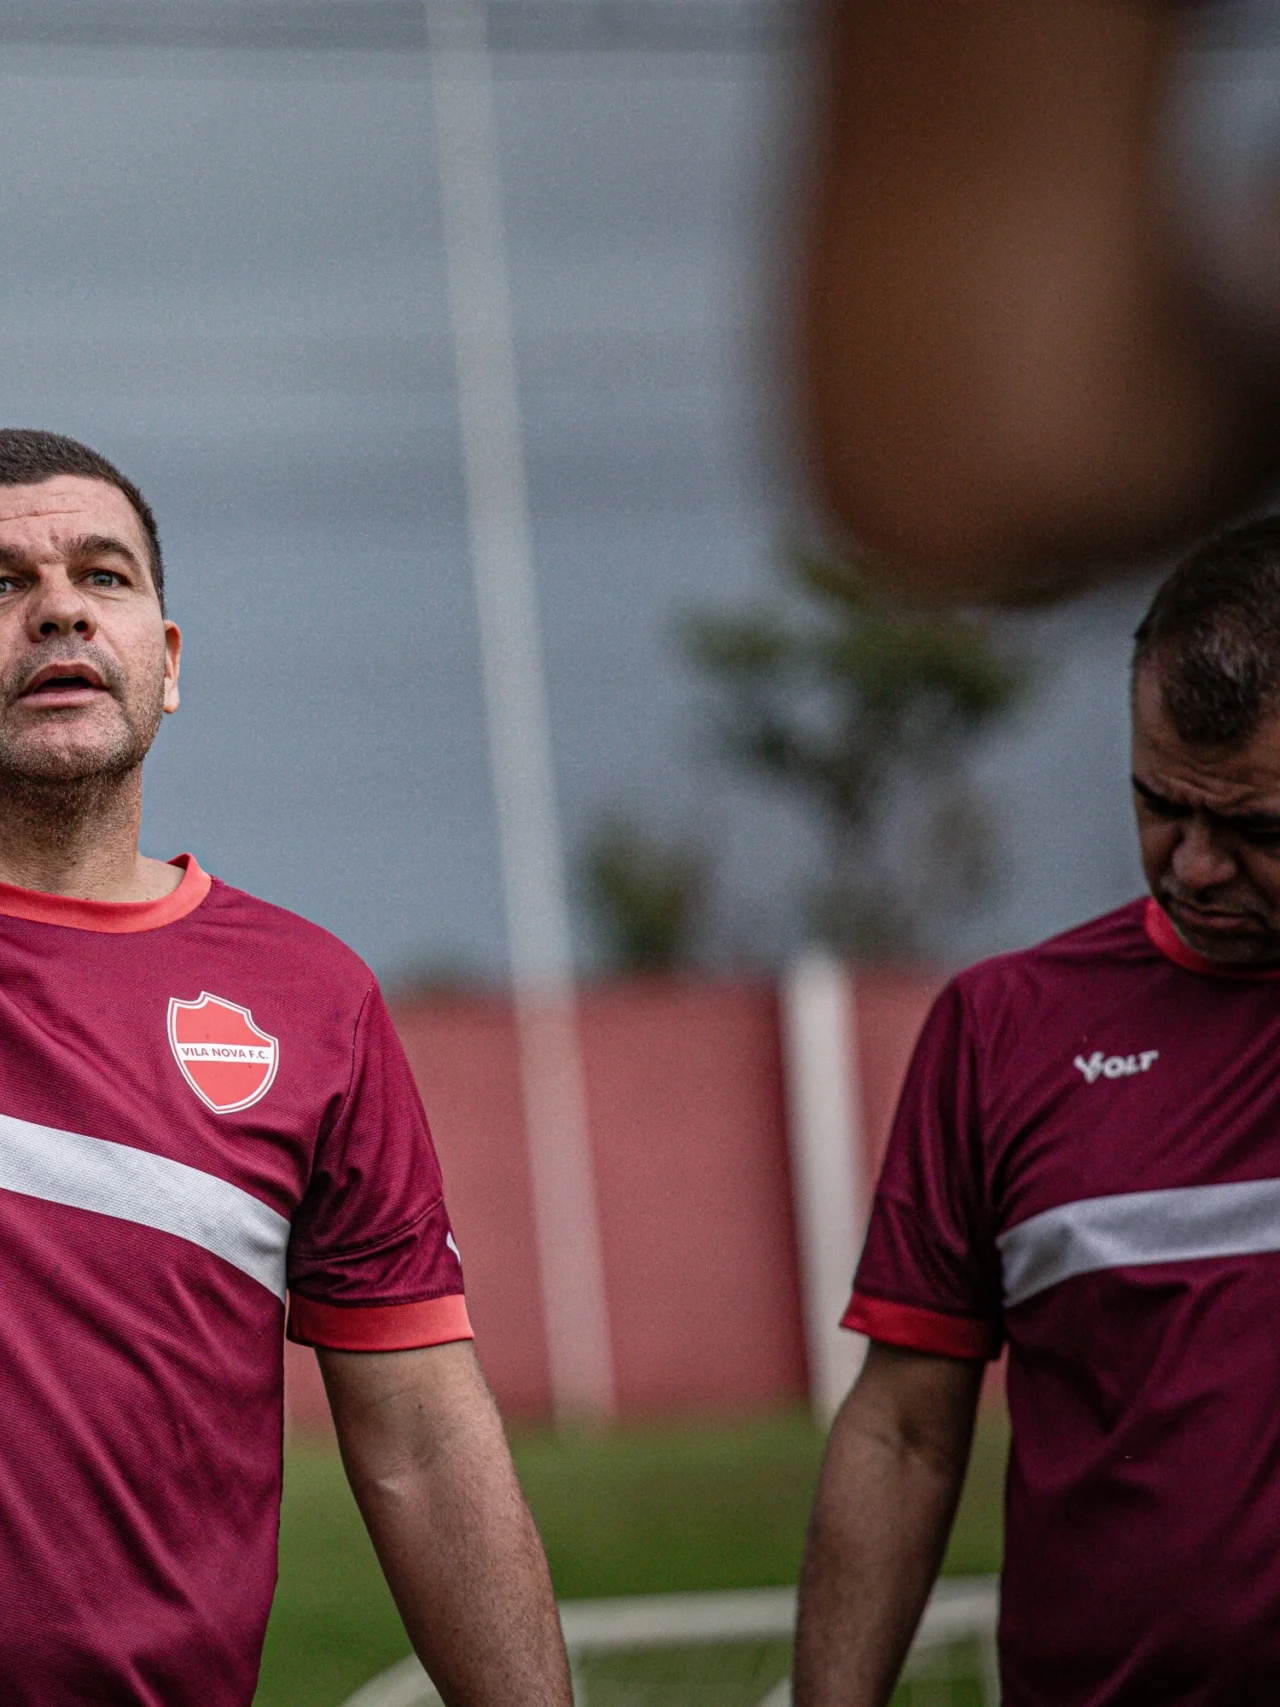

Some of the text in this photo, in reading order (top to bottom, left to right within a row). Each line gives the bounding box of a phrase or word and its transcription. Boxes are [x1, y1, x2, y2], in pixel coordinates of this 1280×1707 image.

[181, 1047, 269, 1060] VILA NOVA F.C.
[1073, 1050, 1159, 1084] VOLT
